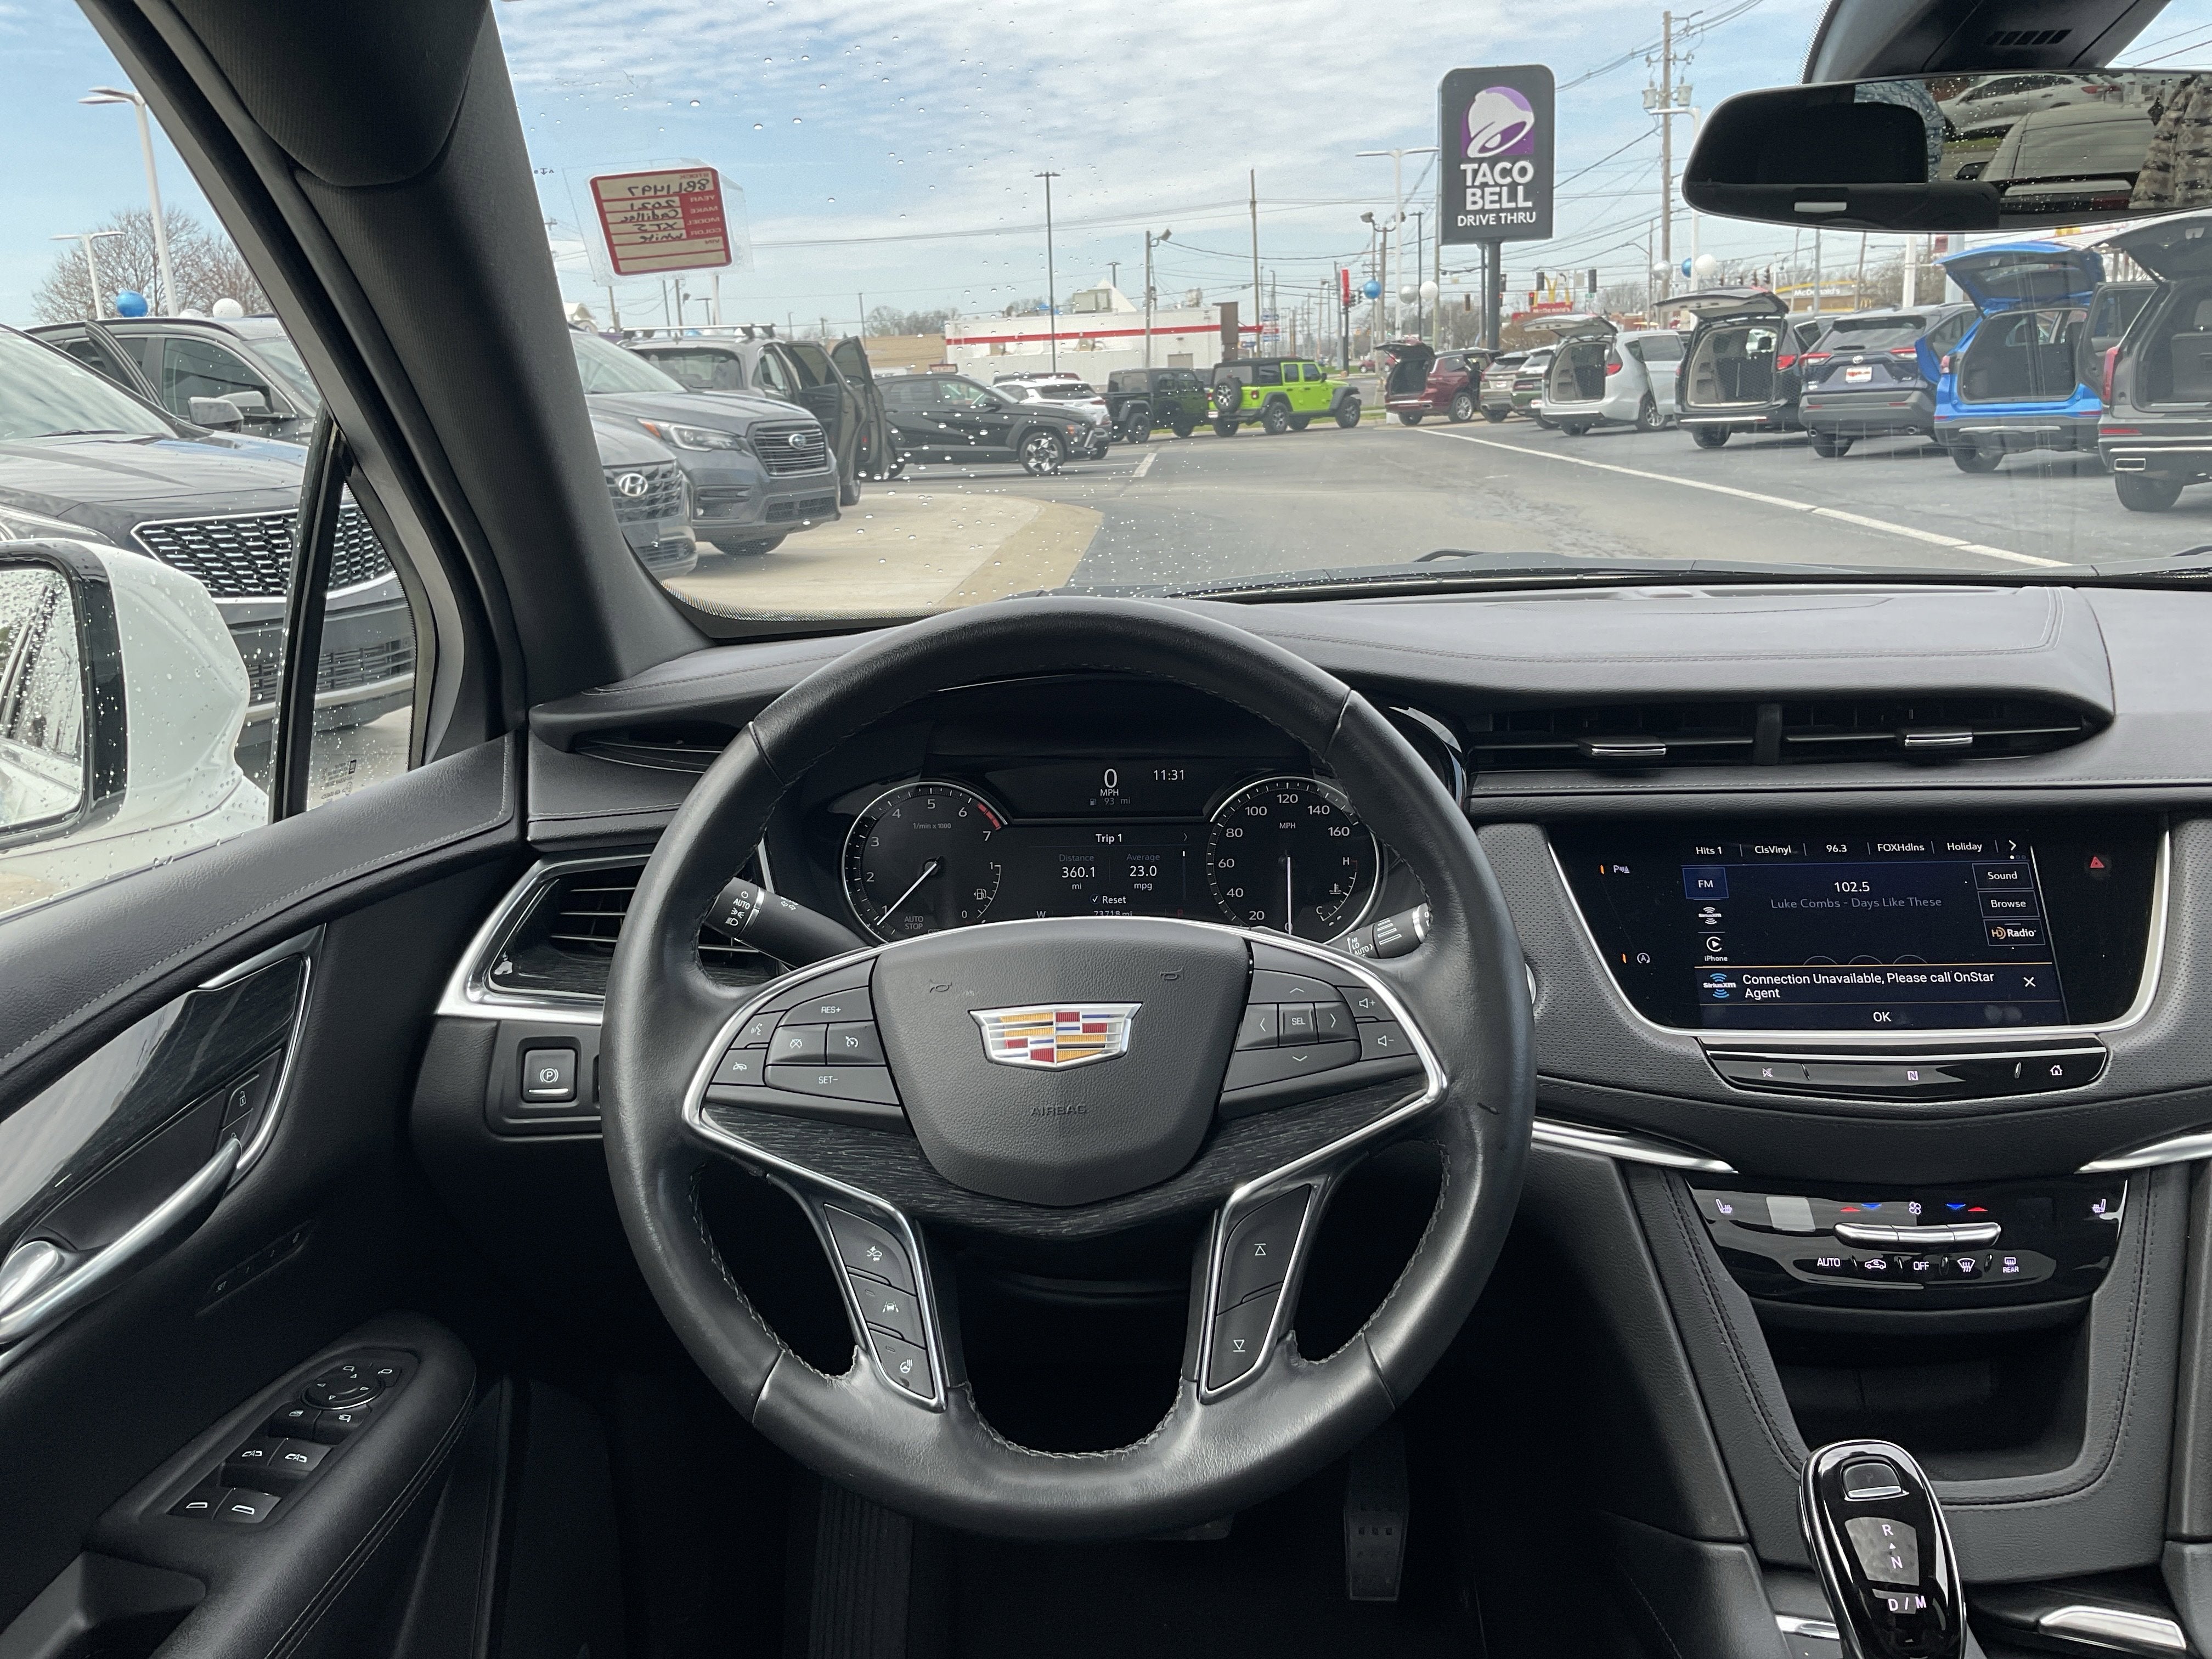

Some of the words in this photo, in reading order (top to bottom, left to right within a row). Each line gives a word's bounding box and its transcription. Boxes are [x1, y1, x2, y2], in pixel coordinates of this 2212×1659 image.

[1460, 160, 1534, 186] TACO
[1466, 185, 1532, 211] BELL
[1457, 213, 1496, 227] DRIVE
[1499, 211, 1536, 224] THRU
[1104, 769, 1118, 788] 0
[1153, 770, 1184, 781] 11:31
[1100, 788, 1119, 797] MPH
[927, 799, 936, 809] 5
[1277, 794, 1299, 804] 120
[892, 808, 901, 818] 4
[958, 807, 967, 817] 6
[1245, 806, 1267, 816] 100
[1307, 805, 1330, 815] 140
[983, 831, 991, 841] 7
[1226, 828, 1243, 838] 80
[1328, 827, 1350, 837] 160
[871, 837, 879, 847] 3
[1096, 833, 1115, 844] Trip
[1118, 833, 1122, 842] 1
[1754, 845, 1791, 855] ClsVinyl
[1826, 844, 1847, 853] 96.3
[1947, 842, 1982, 852] Holiday
[1059, 854, 1094, 862] Distance
[1126, 853, 1160, 863] Average
[1218, 859, 1235, 868] 60
[1062, 866, 1095, 878] 360.1
[1130, 865, 1157, 877] 23.0
[1988, 871, 2018, 880] Sound
[866, 872, 874, 882] 2
[1134, 883, 1152, 891] mpg
[1698, 879, 1713, 888] FM
[1834, 881, 1870, 893] 102.5
[1226, 888, 1244, 898] 40
[733, 898, 751, 910] AUTO
[1102, 895, 1126, 904] Reset
[1771, 899, 1797, 909] Luke
[1801, 898, 1841, 909] Combs
[1851, 898, 1880, 910] Days
[1882, 898, 1905, 907] Like
[1907, 897, 1942, 906] These
[1991, 899, 2026, 908] Browse
[1036, 910, 1046, 918] W
[1317, 906, 1323, 915] C
[1249, 911, 1265, 921] 20
[1354, 946, 1369, 956] AUTO
[1742, 974, 1810, 985] Connection
[1813, 972, 1884, 985] Unavailable,
[1887, 973, 1927, 983] Please
[1930, 972, 1951, 982] call
[1954, 972, 1994, 982] OnStar
[1745, 988, 1780, 1000] Agent
[1291, 1017, 1306, 1025] SEL
[1873, 1012, 1892, 1022] OK
[1030, 1104, 1087, 1117] AIRBAG
[1817, 1257, 1841, 1267] AUTO
[1913, 1261, 1929, 1271] OFF
[1882, 1524, 1894, 1536] R
[1891, 1556, 1903, 1569] N
